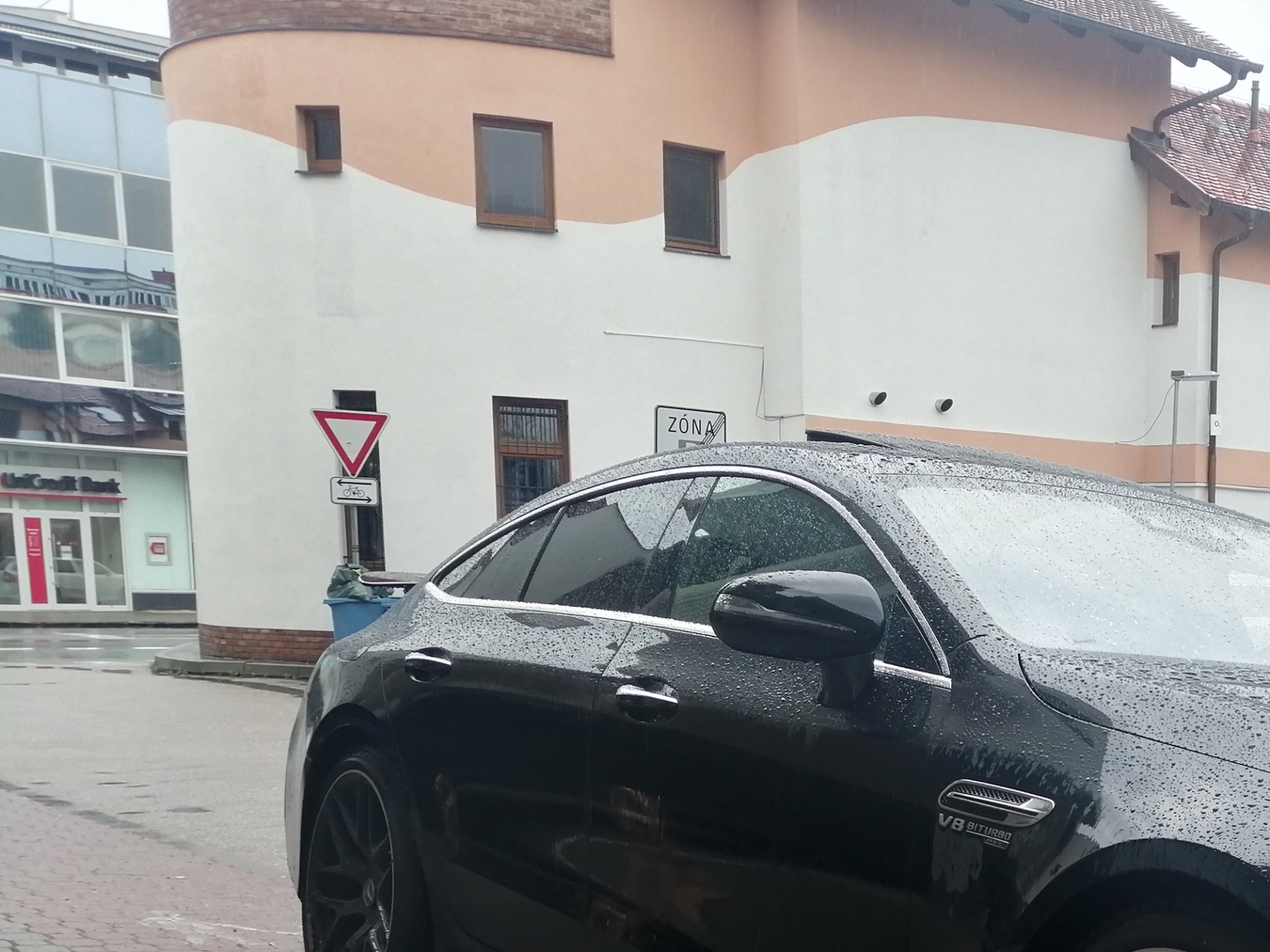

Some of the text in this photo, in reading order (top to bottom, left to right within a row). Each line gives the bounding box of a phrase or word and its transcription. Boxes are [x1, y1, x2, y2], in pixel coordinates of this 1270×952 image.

[668, 414, 715, 436] ZÓNA
[938, 812, 1012, 841] V8 BITURBO
